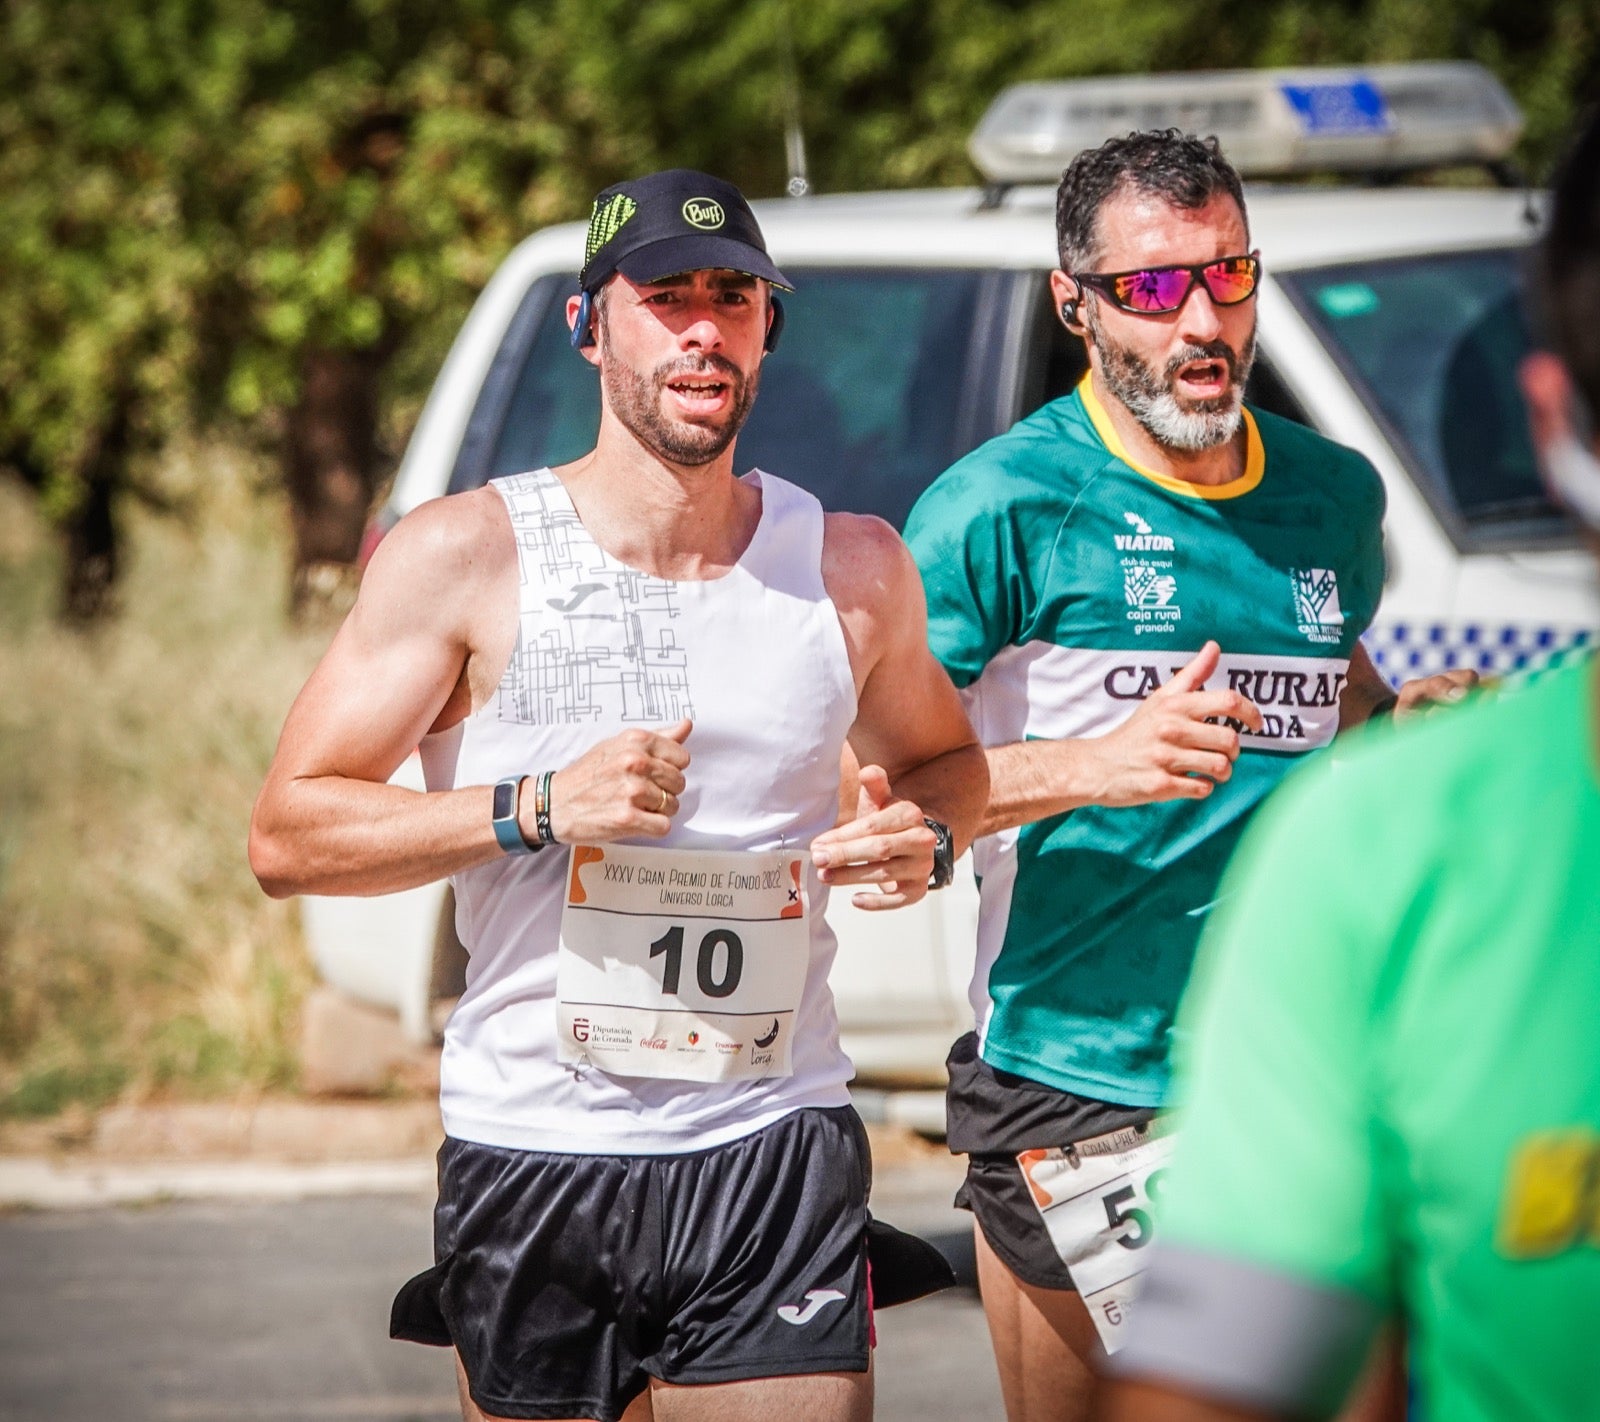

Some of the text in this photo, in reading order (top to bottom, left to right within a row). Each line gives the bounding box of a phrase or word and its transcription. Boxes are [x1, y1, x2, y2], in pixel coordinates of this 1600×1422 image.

[687, 203, 721, 224] Buff
[1113, 534, 1175, 551] VIATOR
[1120, 557, 1138, 567] club
[1127, 608, 1181, 623] caja rural
[1134, 621, 1175, 635] granada
[603, 863, 782, 891] XXXV GRAN PREMIO DE FONDO 2022
[659, 889, 734, 908] UNIVERSO LORCA
[649, 926, 744, 999] 10
[592, 1025, 632, 1036] Diputación
[602, 1035, 633, 1044] Granada
